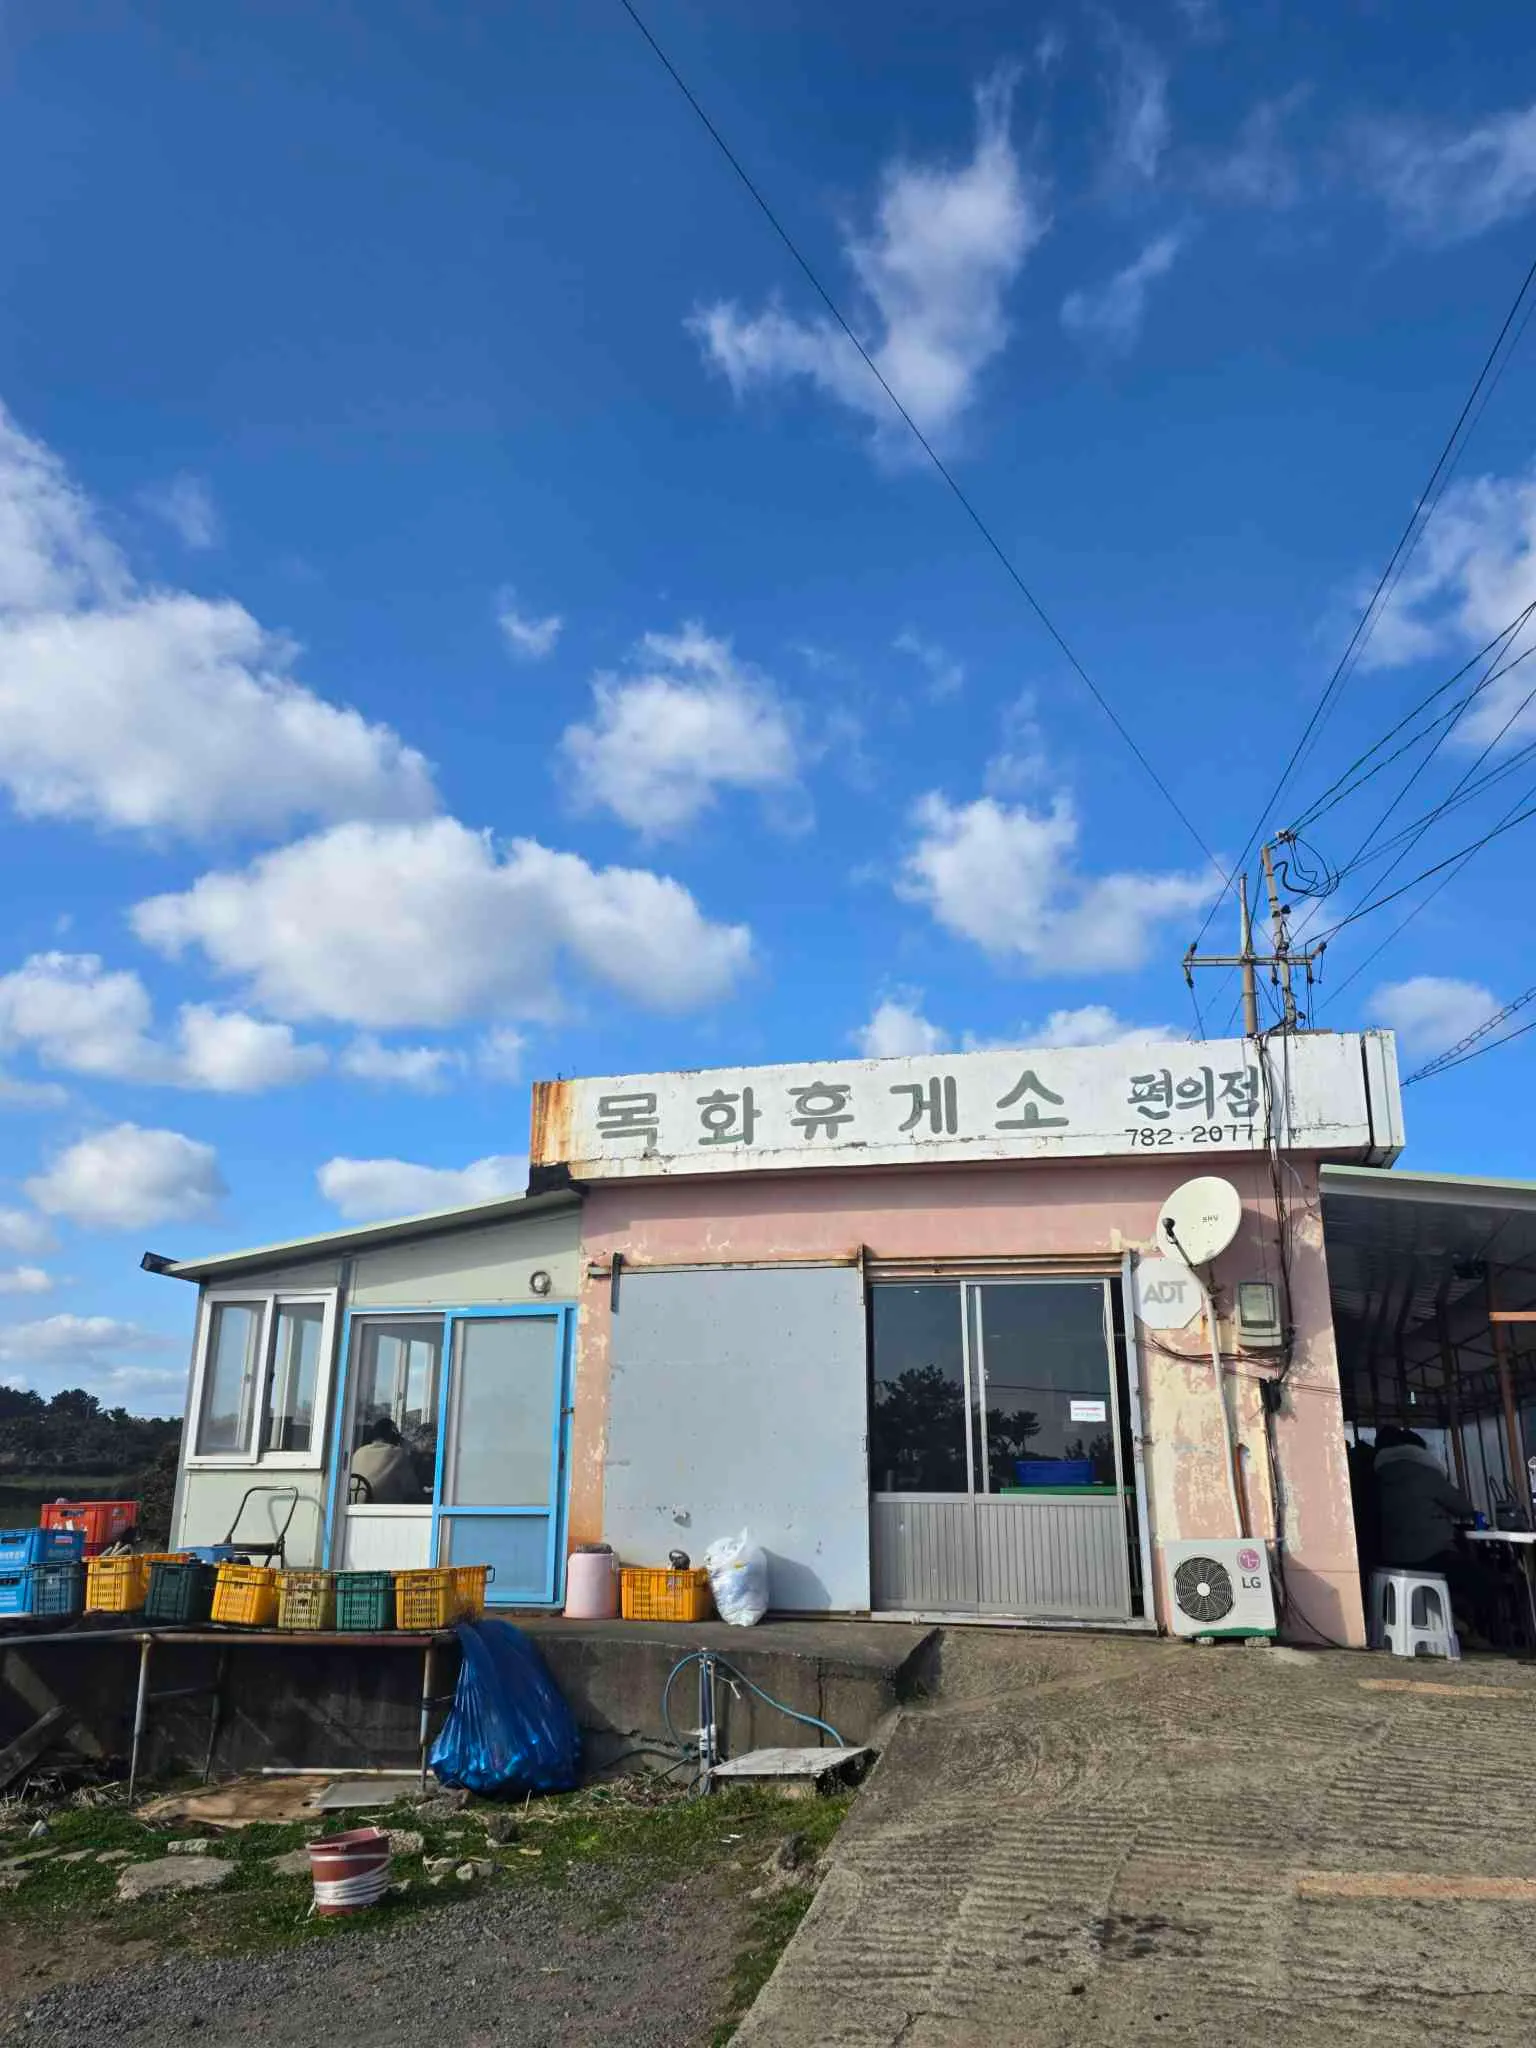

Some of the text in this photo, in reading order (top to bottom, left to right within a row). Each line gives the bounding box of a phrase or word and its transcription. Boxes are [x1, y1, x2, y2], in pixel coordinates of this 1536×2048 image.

[1127, 1065, 1260, 1120] 편의점
[1143, 1281, 1187, 1304] ADT
[1241, 1576, 1262, 1589] LG
